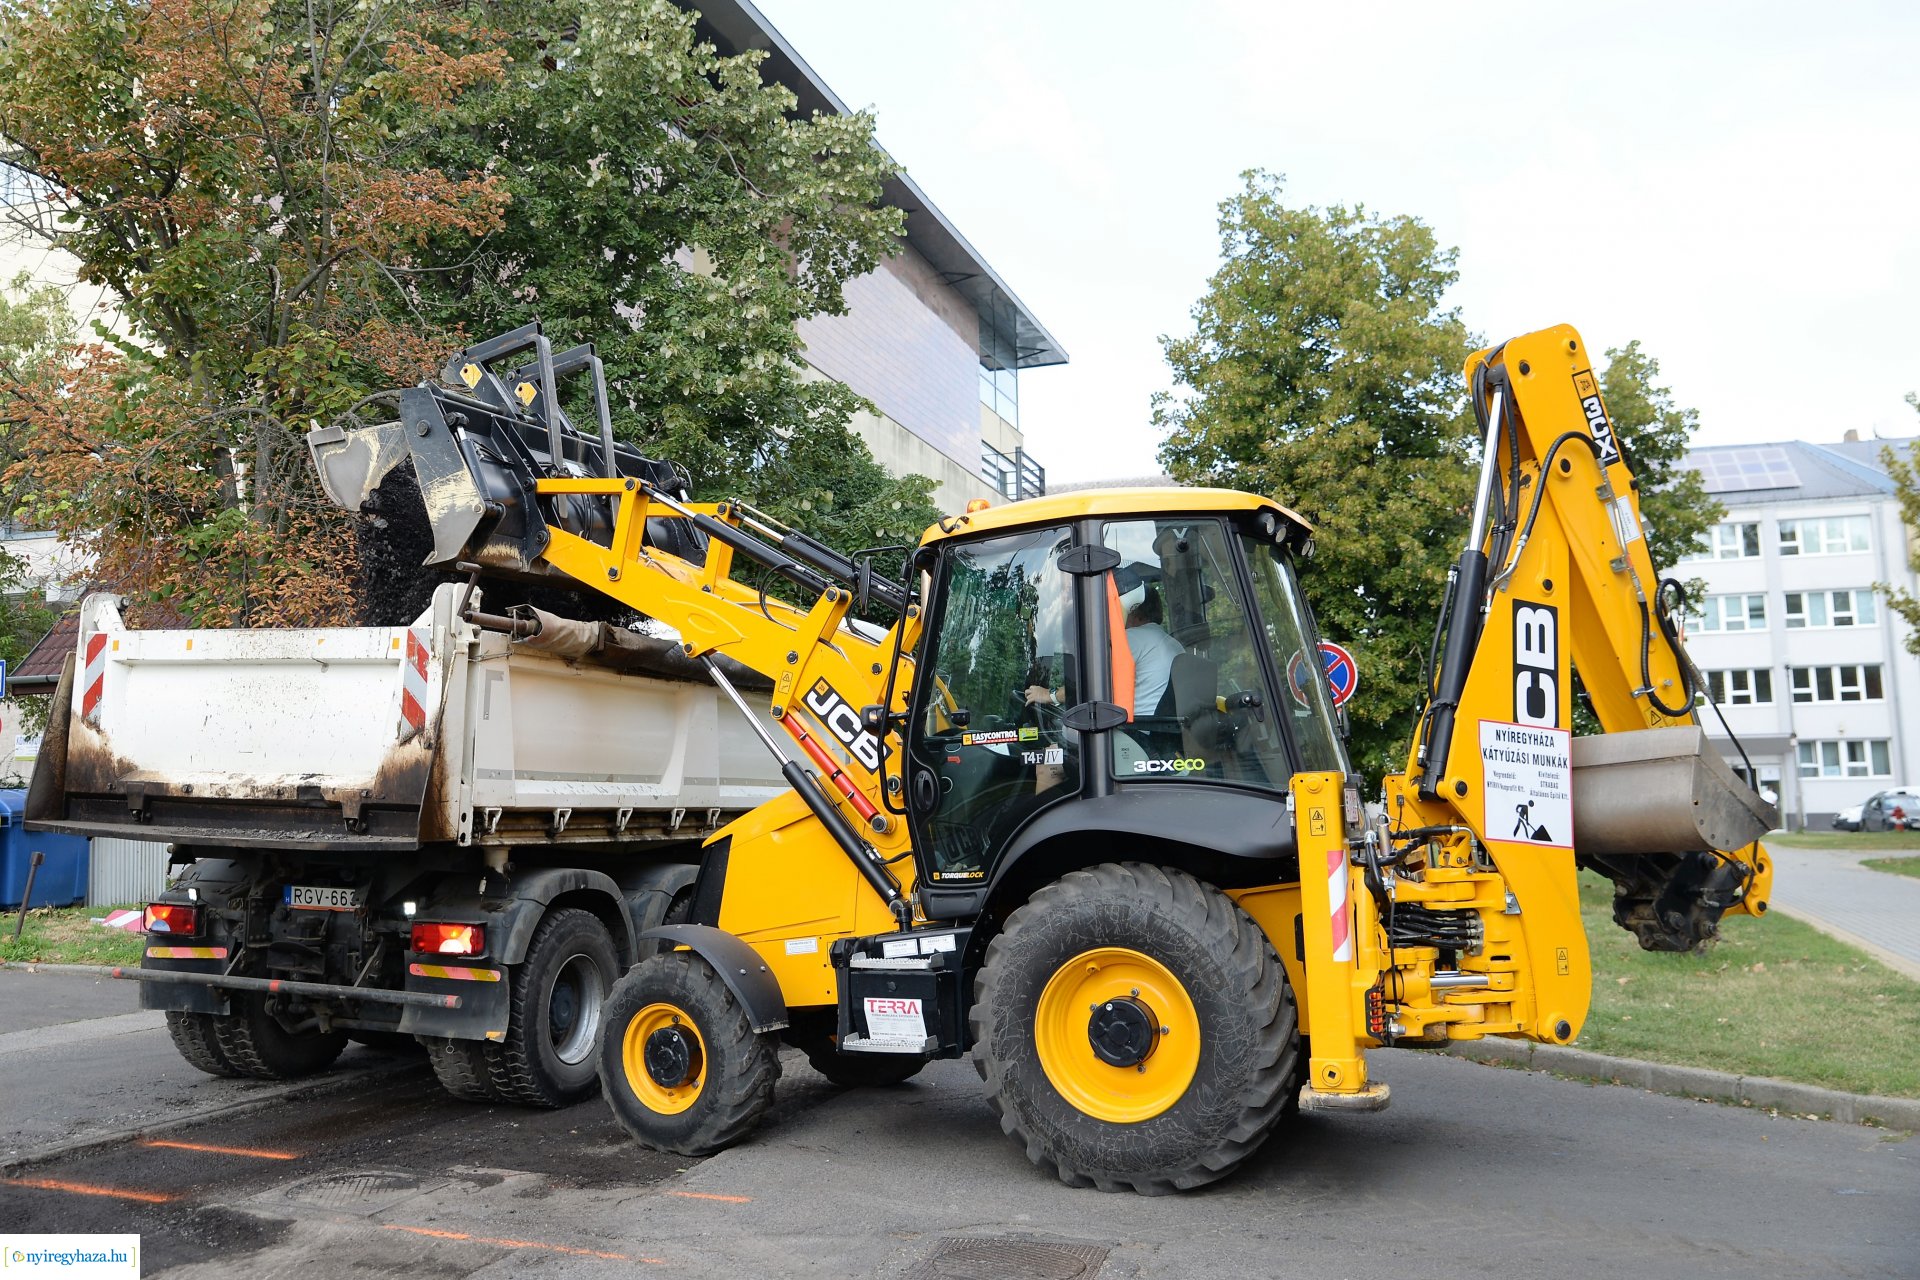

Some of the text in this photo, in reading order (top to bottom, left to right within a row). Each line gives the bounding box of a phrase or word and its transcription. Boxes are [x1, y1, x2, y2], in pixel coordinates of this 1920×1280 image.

[1583, 396, 1617, 459] 3CX
[1516, 607, 1556, 728] CB
[806, 690, 887, 770] JCB
[972, 730, 1018, 743] EASYCONTROL
[1495, 727, 1555, 748] NYÍREGYHÁZA
[1133, 758, 1205, 773] 3CXeco
[1483, 745, 1568, 769] KÁTYÚZÁSI MUNKÁK
[866, 999, 920, 1015] TERRA
